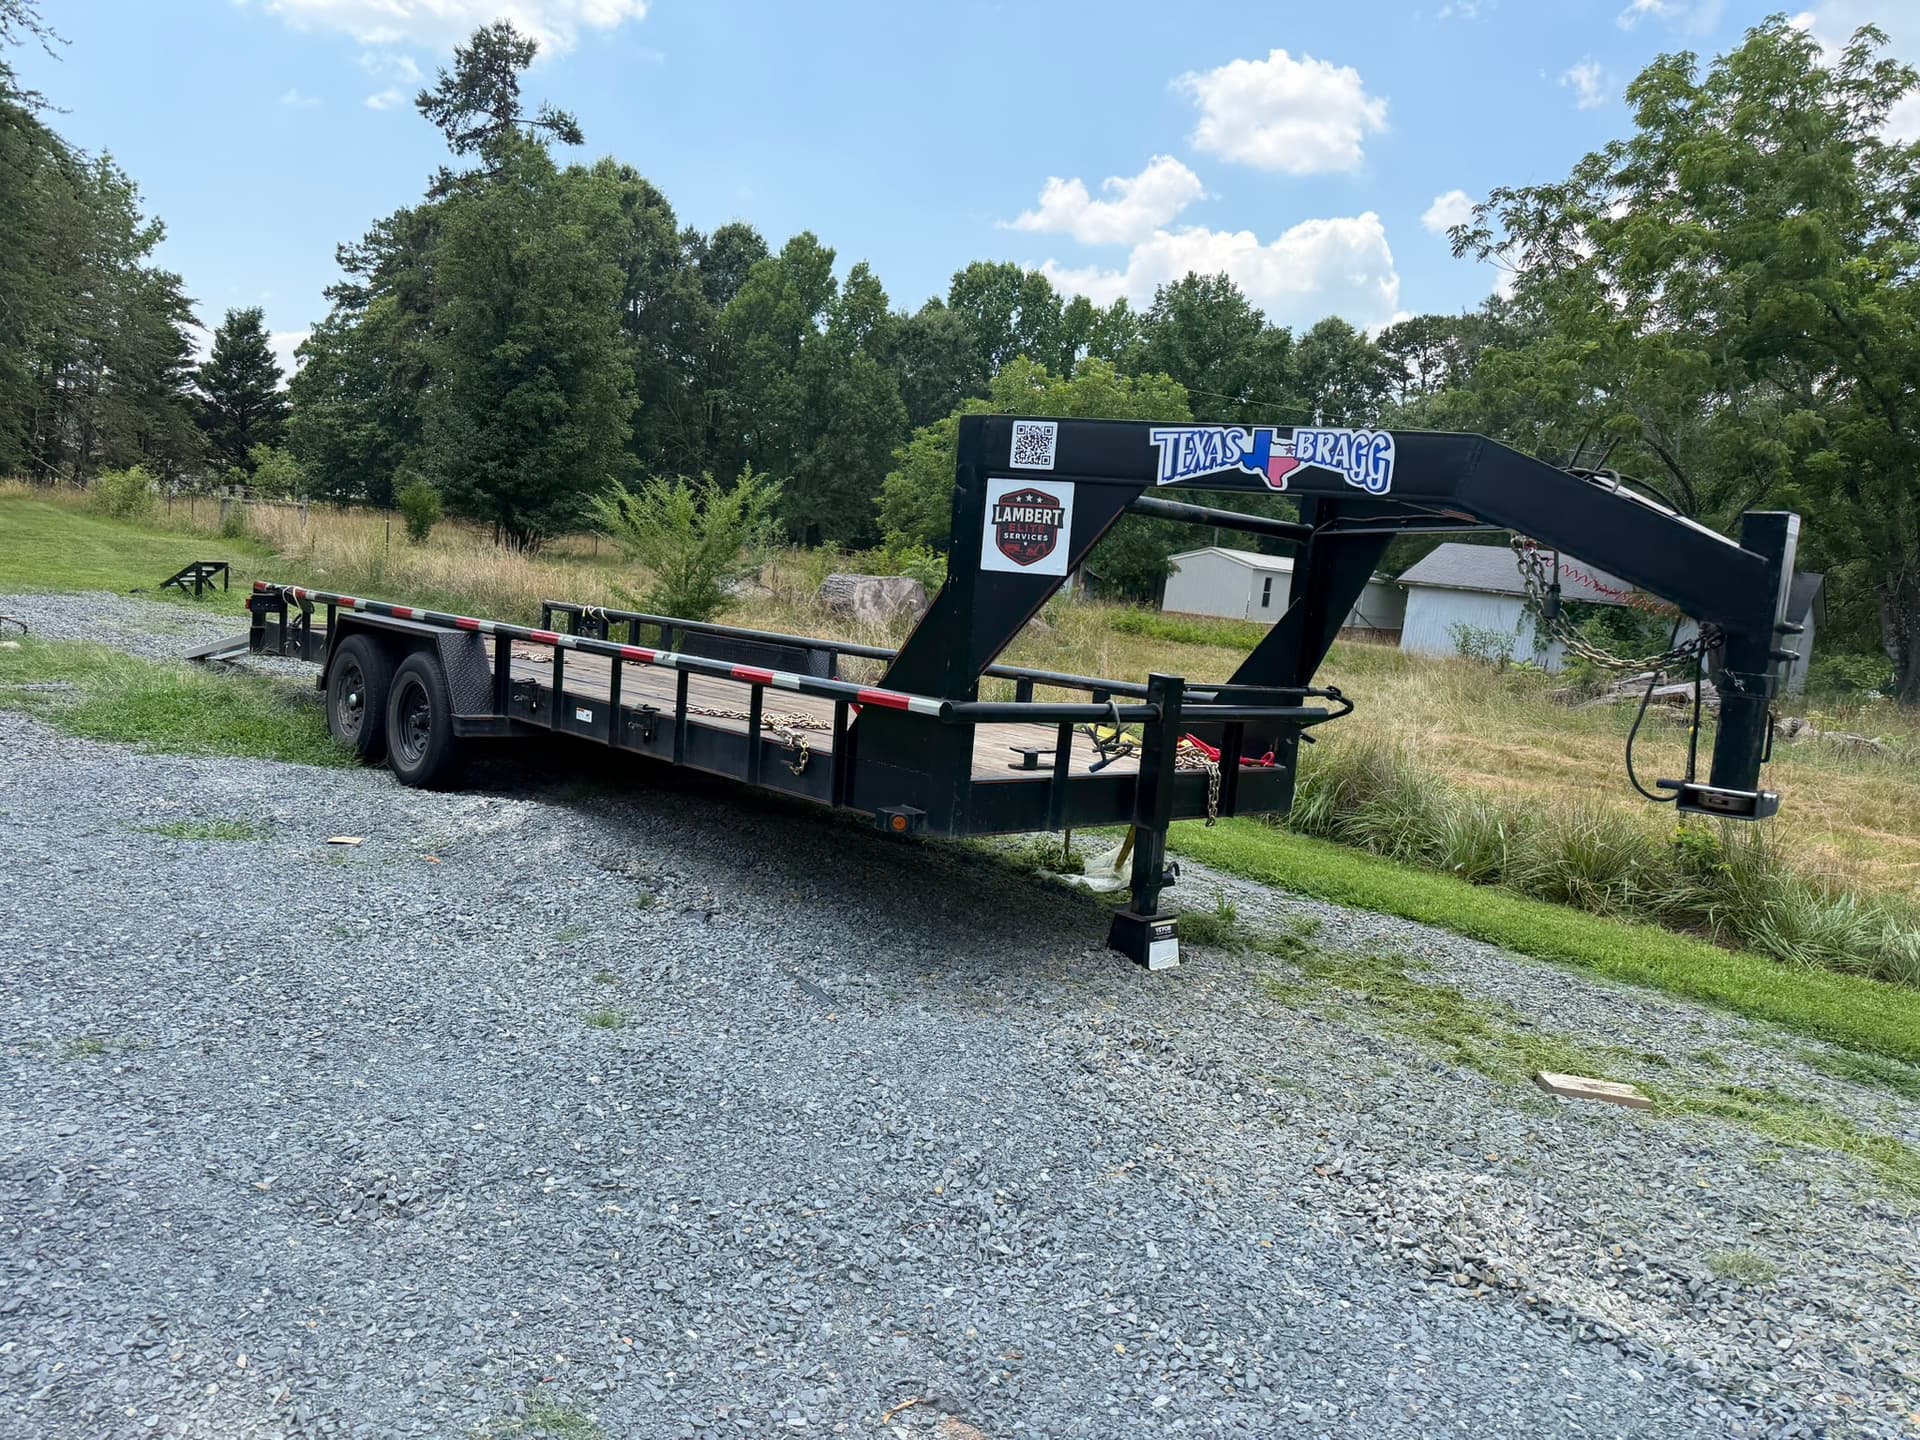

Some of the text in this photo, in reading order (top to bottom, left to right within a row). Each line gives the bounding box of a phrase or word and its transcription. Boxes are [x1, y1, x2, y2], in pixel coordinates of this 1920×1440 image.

[1154, 430, 1391, 492] TEXAS BRAGG
[994, 506, 1062, 526] LAMBERT
[1008, 523, 1046, 533] ELITE
[1003, 532, 1049, 542] SERVICES
